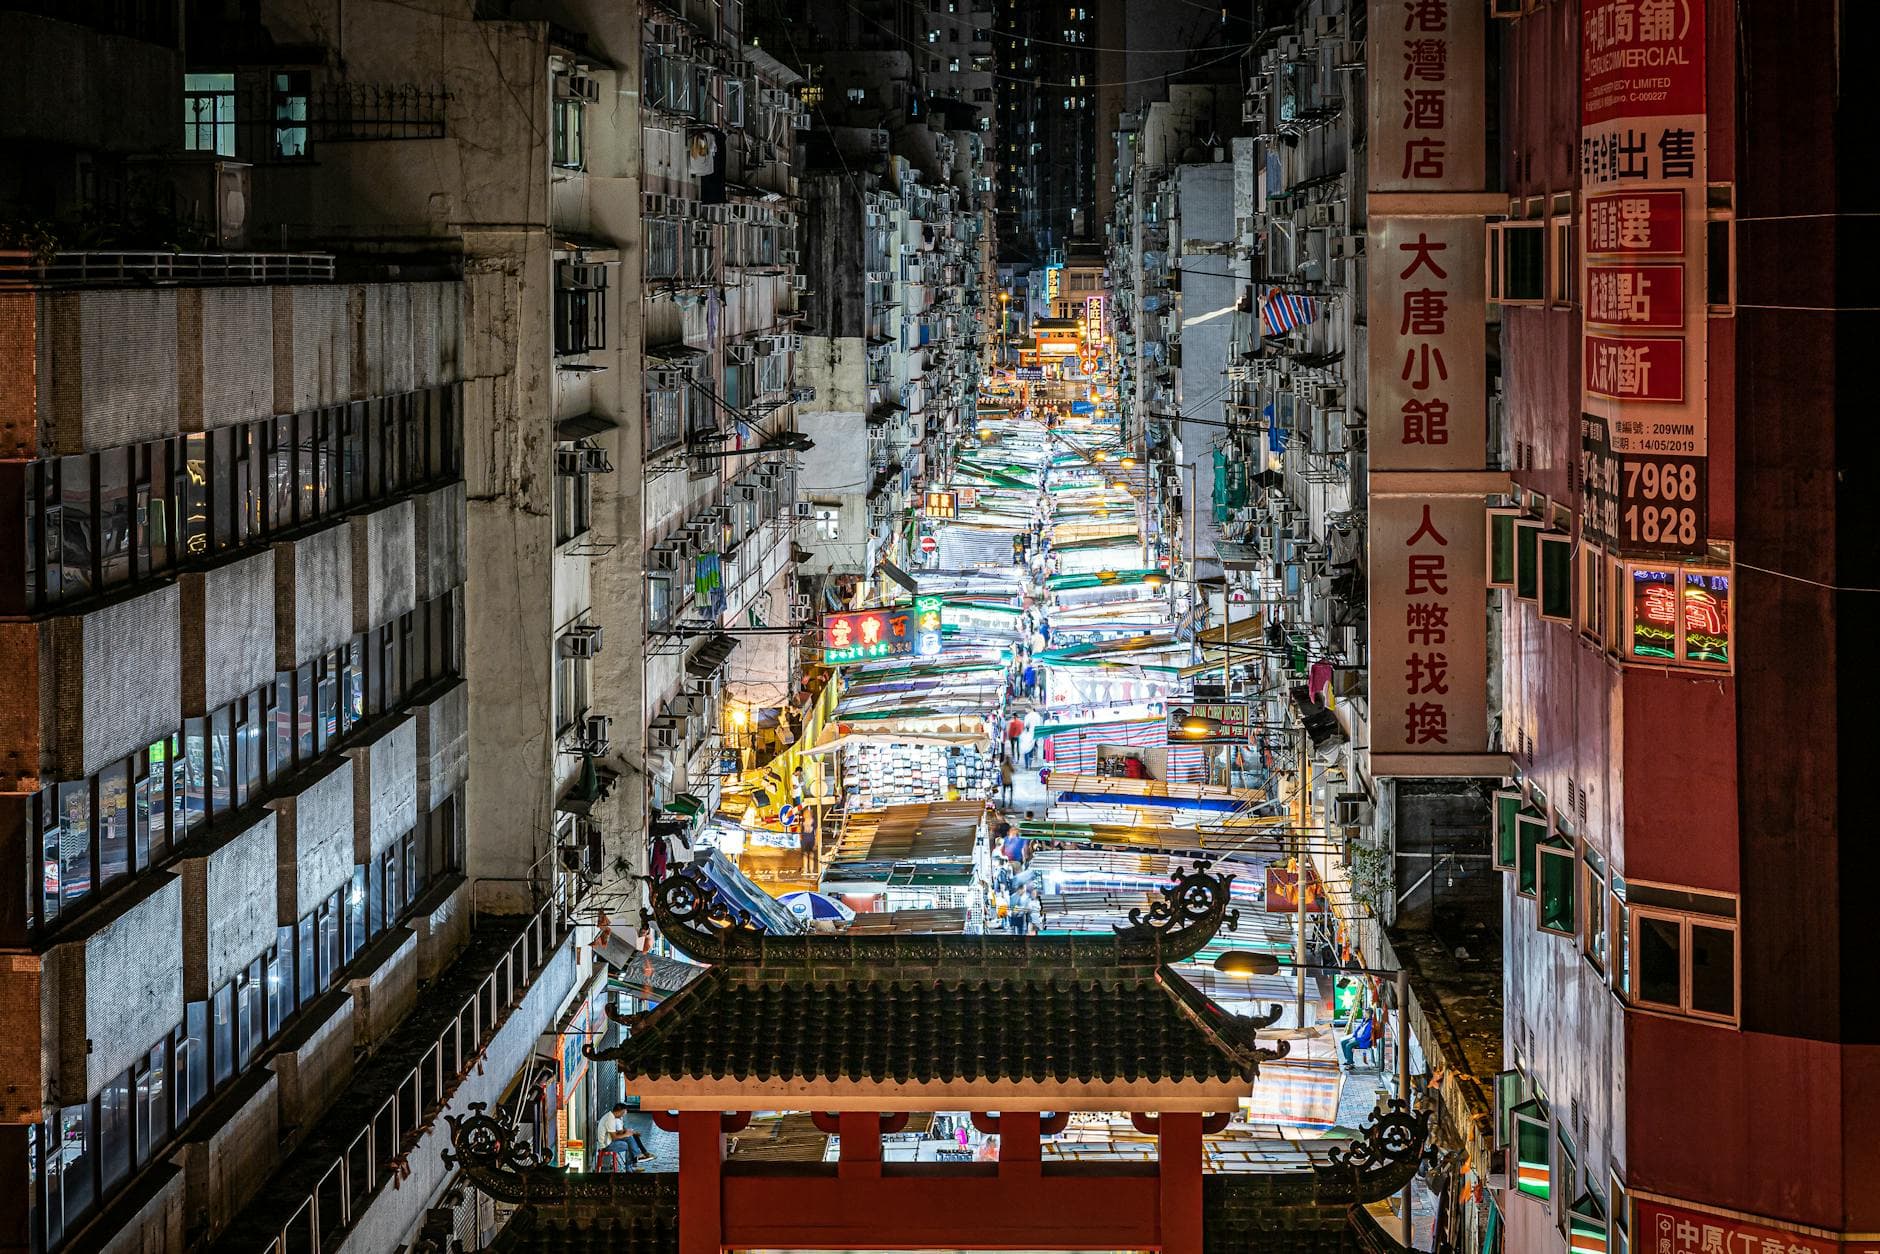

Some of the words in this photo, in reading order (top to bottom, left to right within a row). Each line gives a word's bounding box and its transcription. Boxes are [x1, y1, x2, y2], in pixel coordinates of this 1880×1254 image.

[1402, 0, 1448, 180] 港灣酒店
[1632, 77, 1671, 89] LIMITED
[1399, 233, 1449, 445] 大唐小館
[1639, 439, 1695, 452] 14/05/2019
[1653, 423, 1695, 435] 209WIM
[1623, 462, 1697, 502] 7968
[1624, 504, 1697, 546] 1828
[1405, 504, 1448, 744] 人民幣找換
